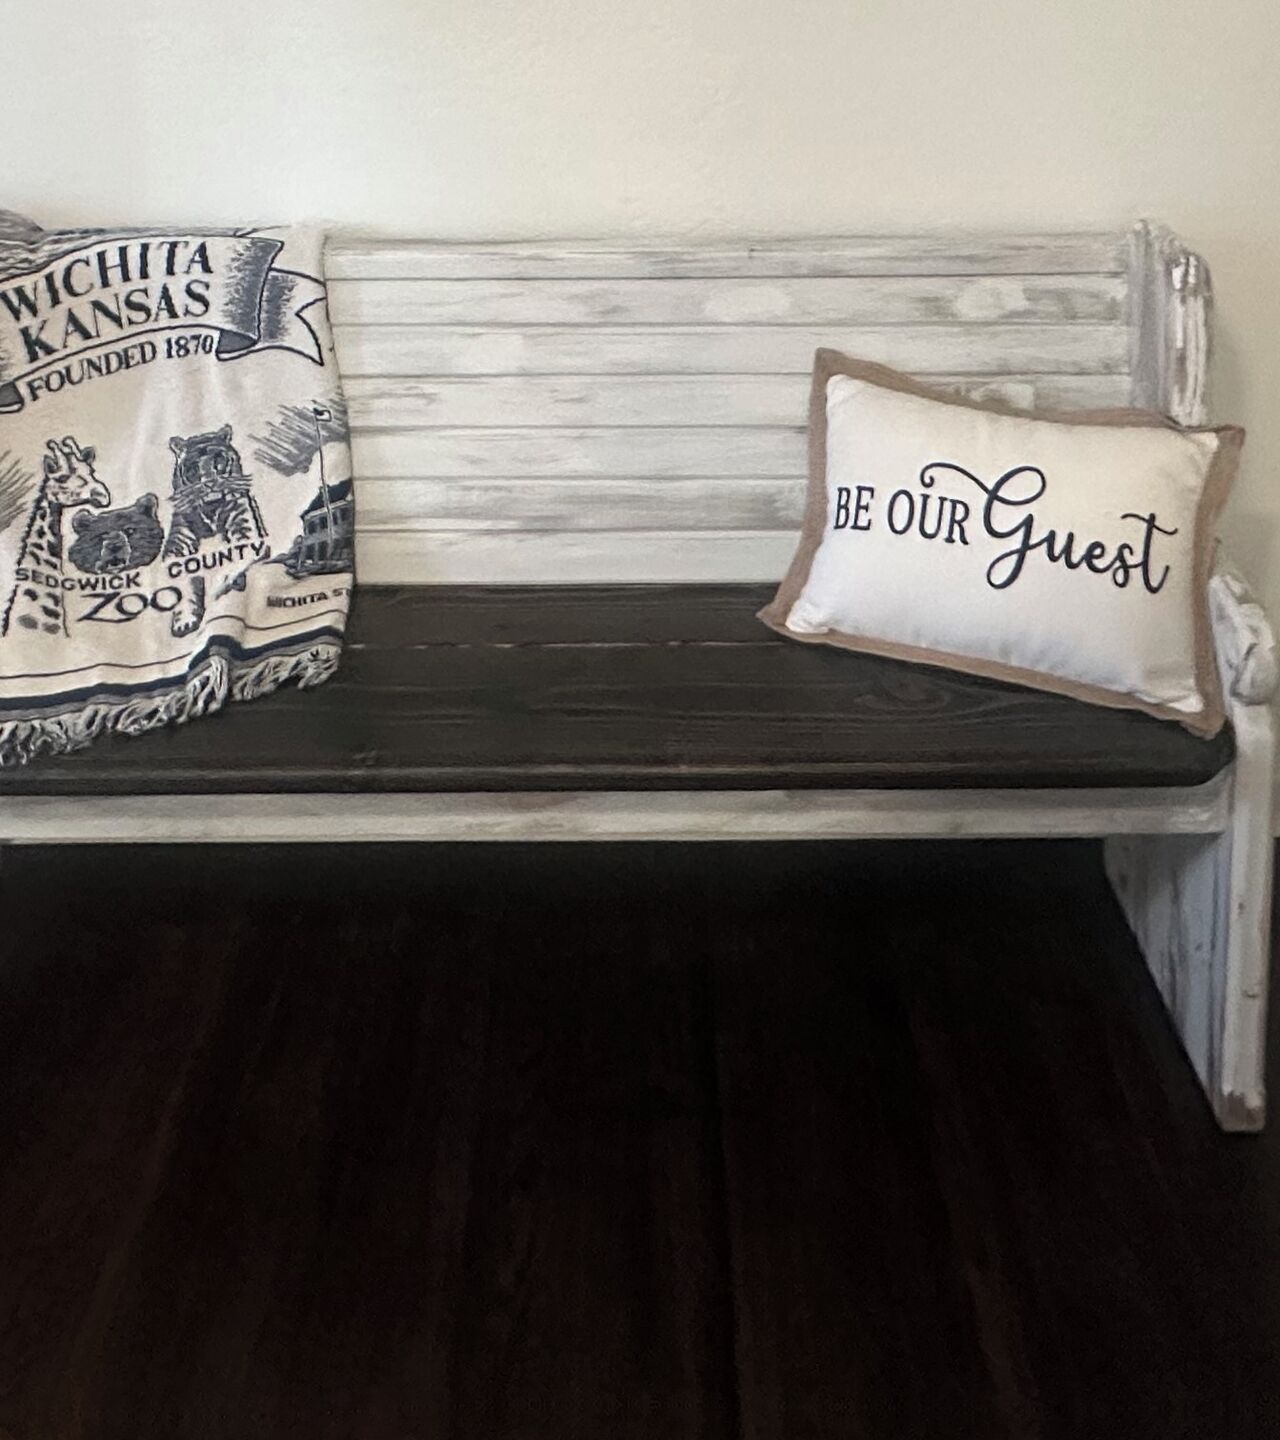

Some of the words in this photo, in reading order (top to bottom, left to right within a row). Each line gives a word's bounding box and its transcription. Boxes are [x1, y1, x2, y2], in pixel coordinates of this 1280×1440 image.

[19, 278, 210, 363] KANSAS
[26, 340, 157, 402] FOUNDED
[164, 333, 214, 359] 1870
[833, 485, 874, 531] BE
[887, 488, 970, 545] OUR
[920, 462, 1178, 594] Guest
[15, 568, 141, 591] SEDGWICK
[168, 540, 265, 578] COUNTY
[77, 586, 183, 623] ZOO
